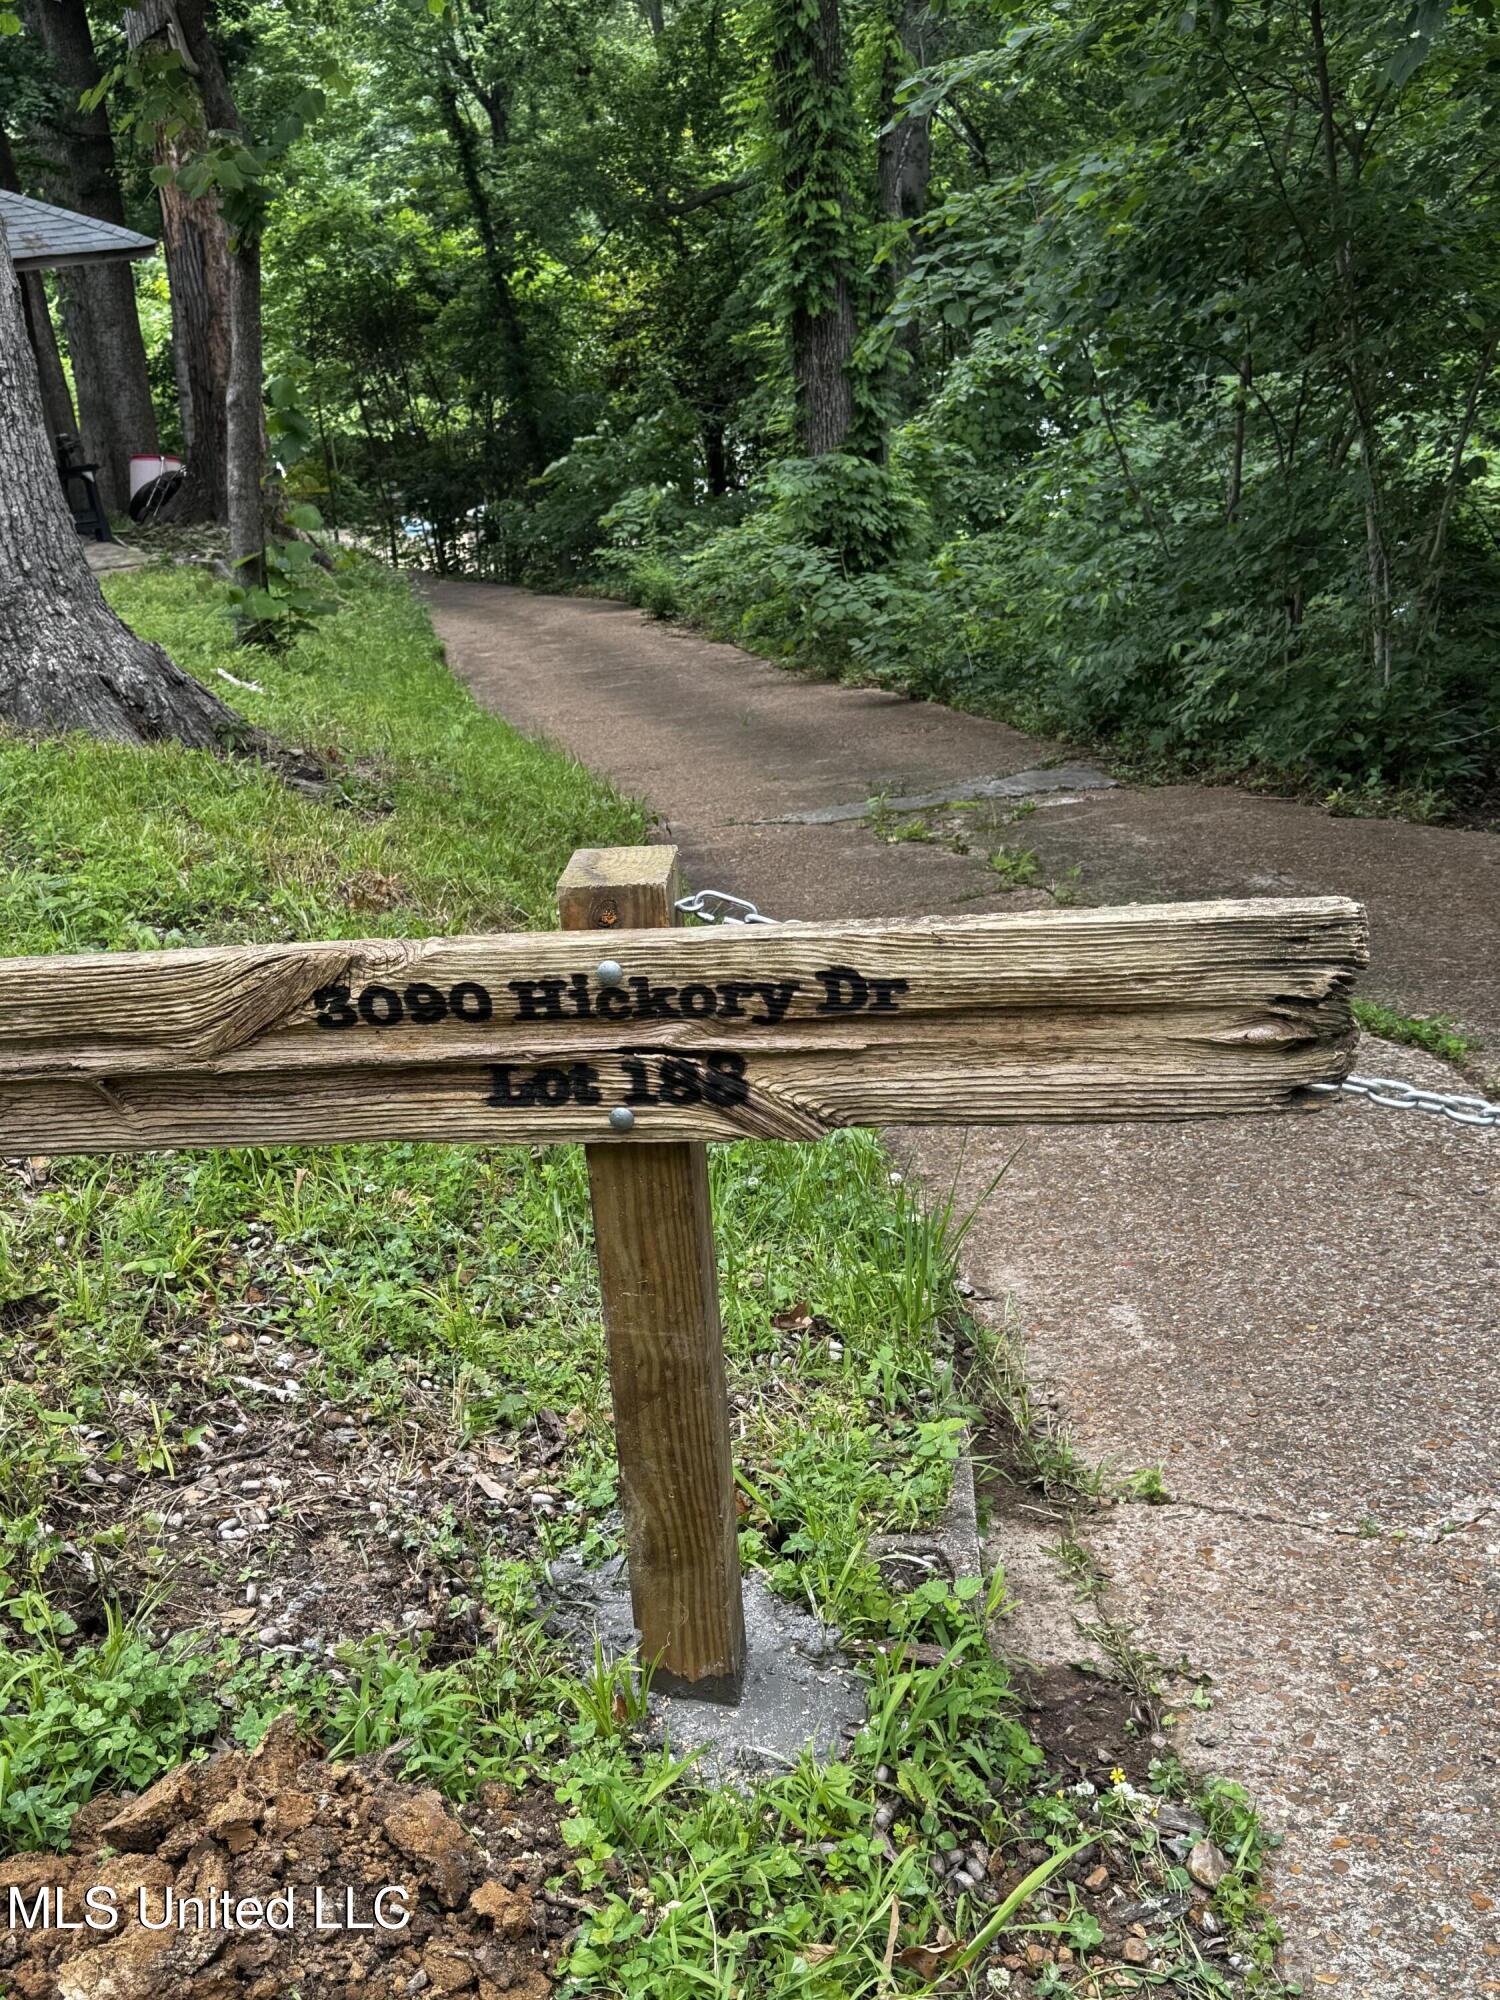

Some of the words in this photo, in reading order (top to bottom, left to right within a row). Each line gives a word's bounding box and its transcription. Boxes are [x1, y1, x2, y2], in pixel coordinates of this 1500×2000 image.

[314, 982, 492, 1028] 3090
[508, 972, 800, 1025] Hickory
[816, 966, 910, 1014] Dr
[483, 1063, 602, 1107] Lot
